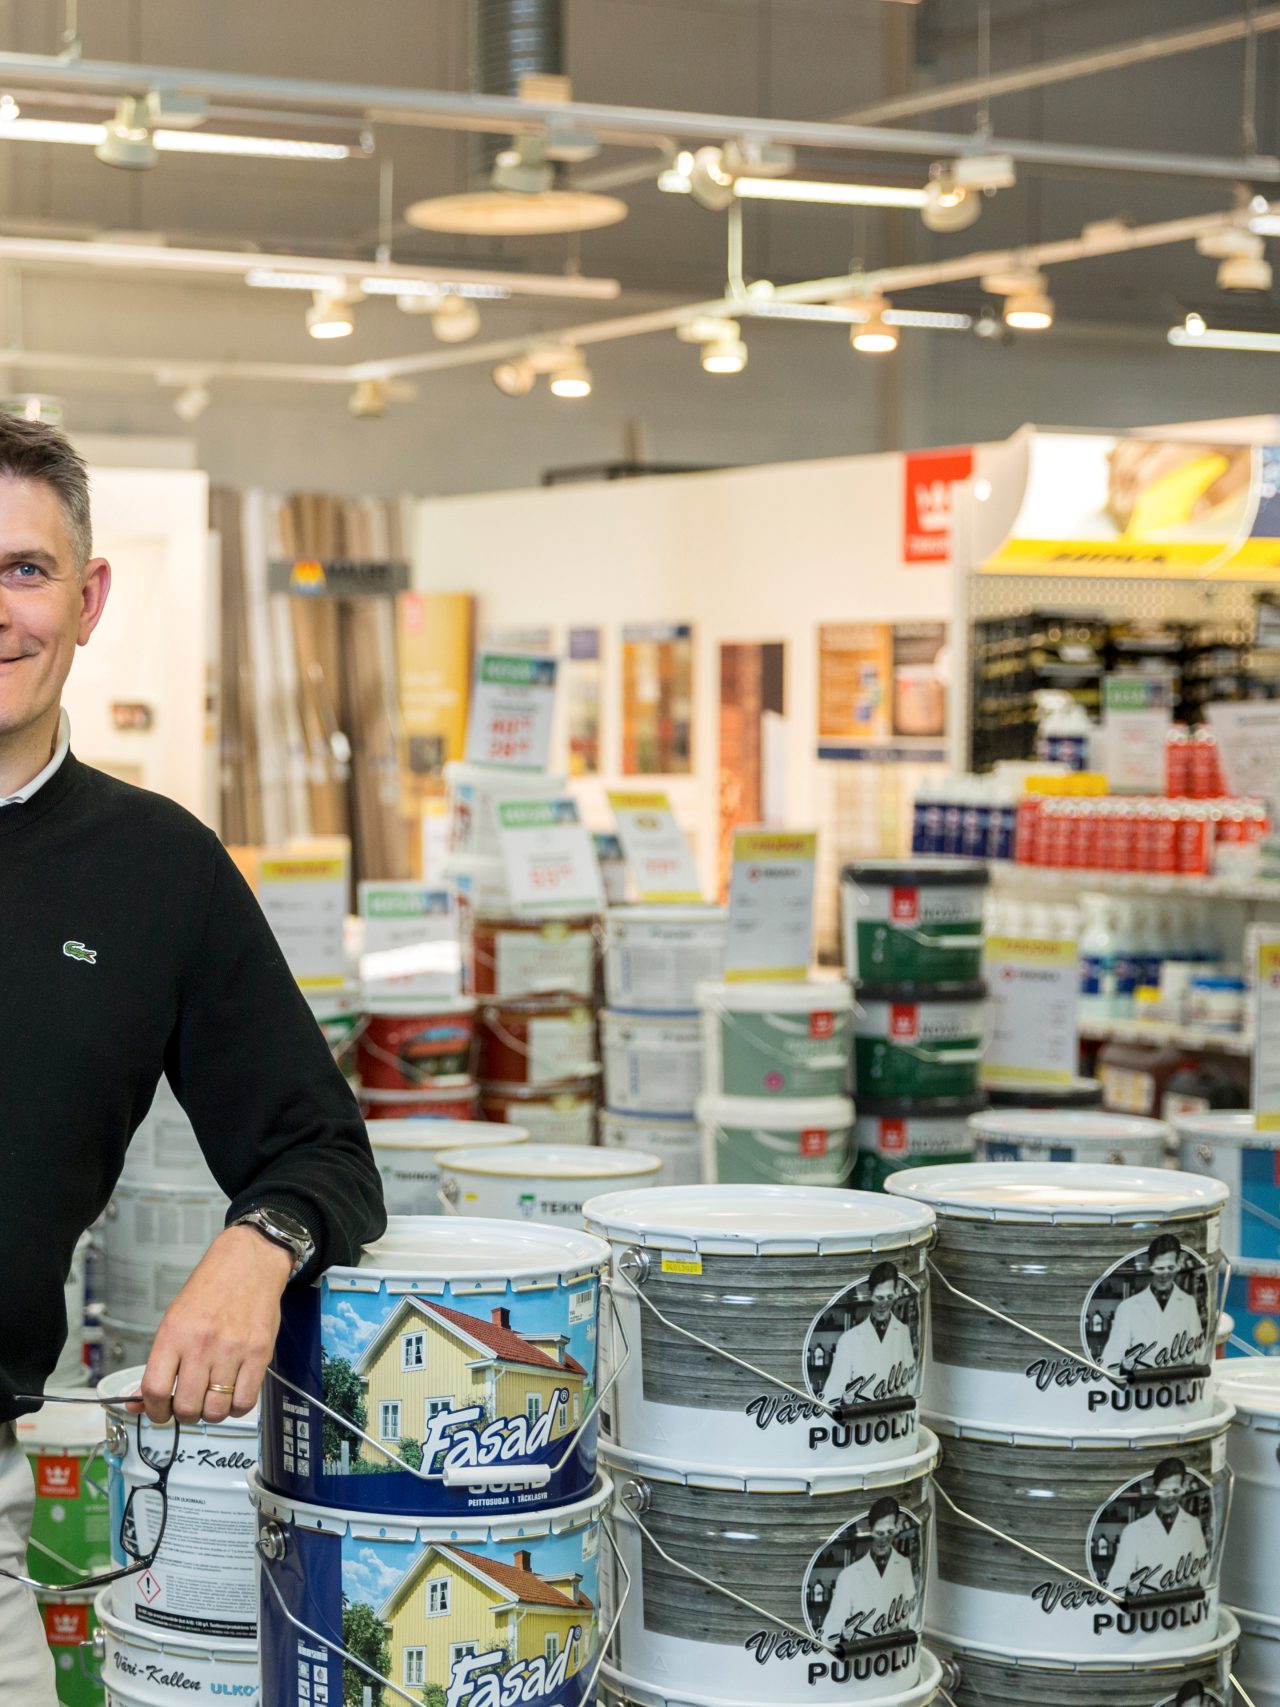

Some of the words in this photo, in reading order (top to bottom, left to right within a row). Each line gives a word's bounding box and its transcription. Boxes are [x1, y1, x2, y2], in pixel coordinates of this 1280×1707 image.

[468, 1497, 510, 1507] PEITTOSUOJA
[114, 1651, 201, 1691] Väri-Kallen
[210, 1682, 259, 1697] ULKO
